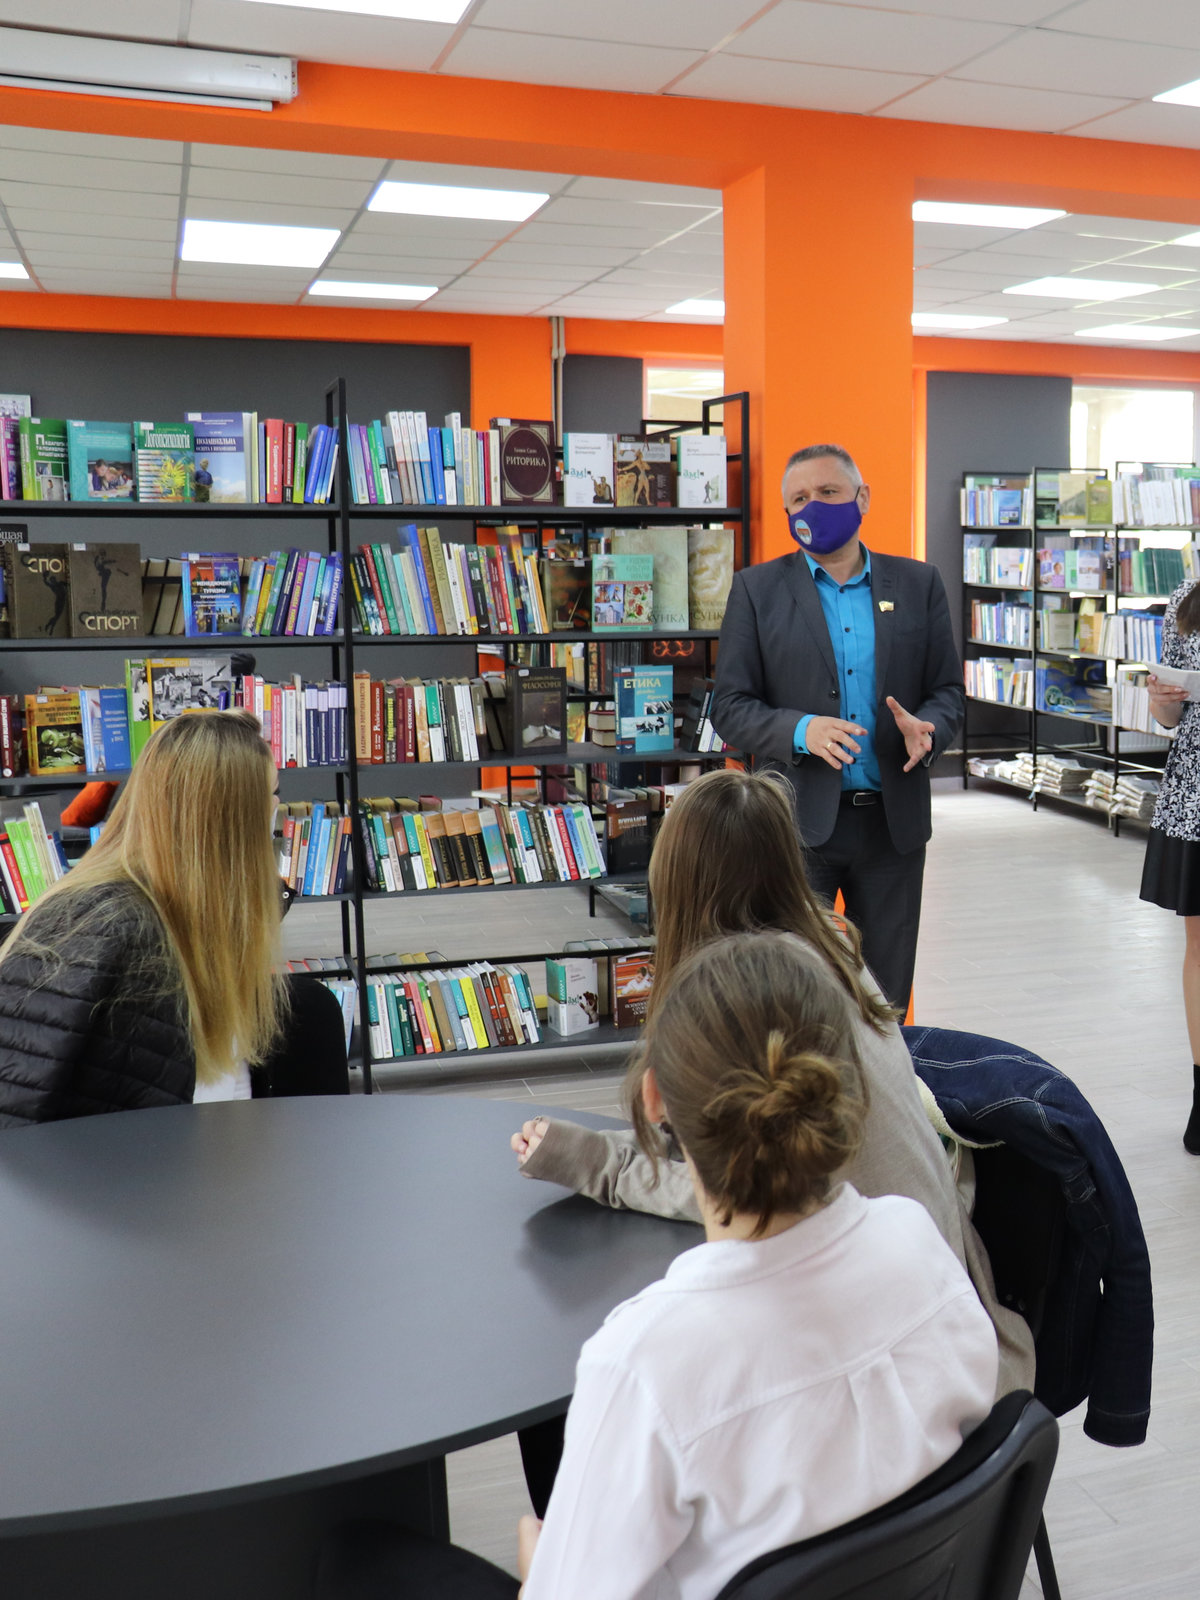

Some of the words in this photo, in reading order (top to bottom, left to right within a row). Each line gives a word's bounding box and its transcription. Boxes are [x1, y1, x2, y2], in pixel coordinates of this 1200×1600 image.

[506, 456, 546, 467] РИТОРИКА
[27, 558, 65, 573] СПО
[85, 616, 139, 630] СПОРТ
[522, 681, 561, 689] ФІЛОСОФІЯ
[624, 678, 661, 689] ЕТИКА
